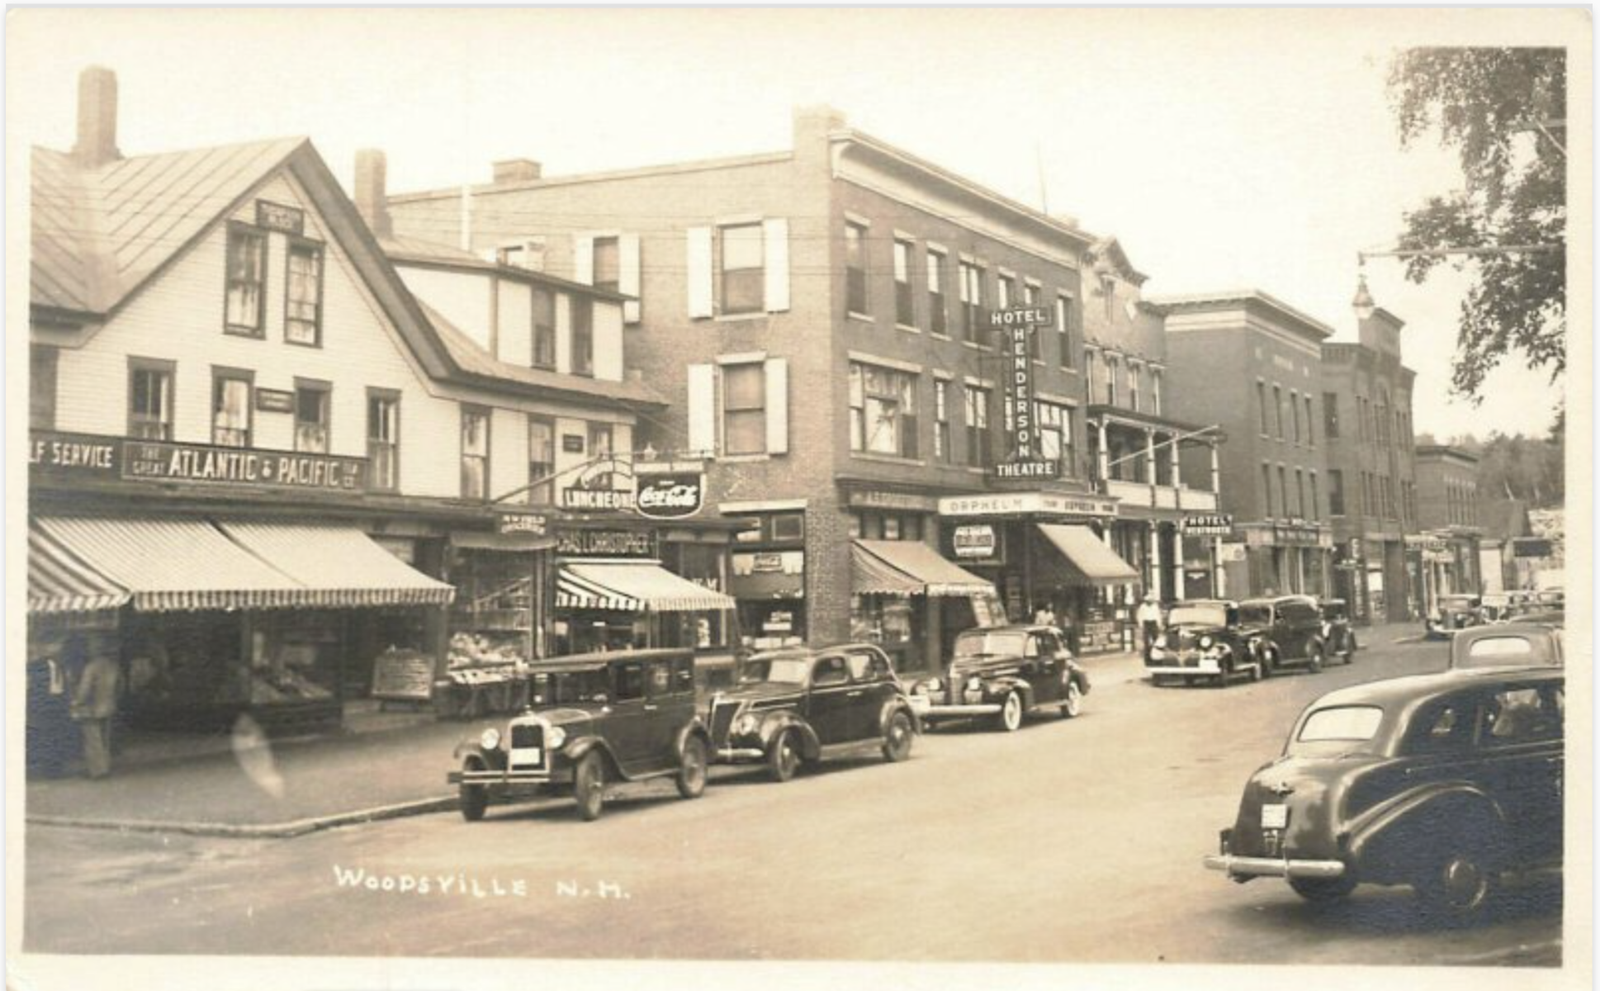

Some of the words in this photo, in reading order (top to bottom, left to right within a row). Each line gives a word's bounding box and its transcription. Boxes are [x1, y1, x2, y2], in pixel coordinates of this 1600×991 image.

[991, 309, 1046, 325] HOTEL
[1014, 328, 1030, 457] HENDERSON
[52, 443, 114, 469] SERVICE
[168, 449, 257, 481] ATLANTIC
[277, 458, 339, 487] PACIFIC
[997, 462, 1054, 477] THEATRE
[638, 484, 698, 508] Coca-Cola
[1189, 515, 1226, 526] HOTEL
